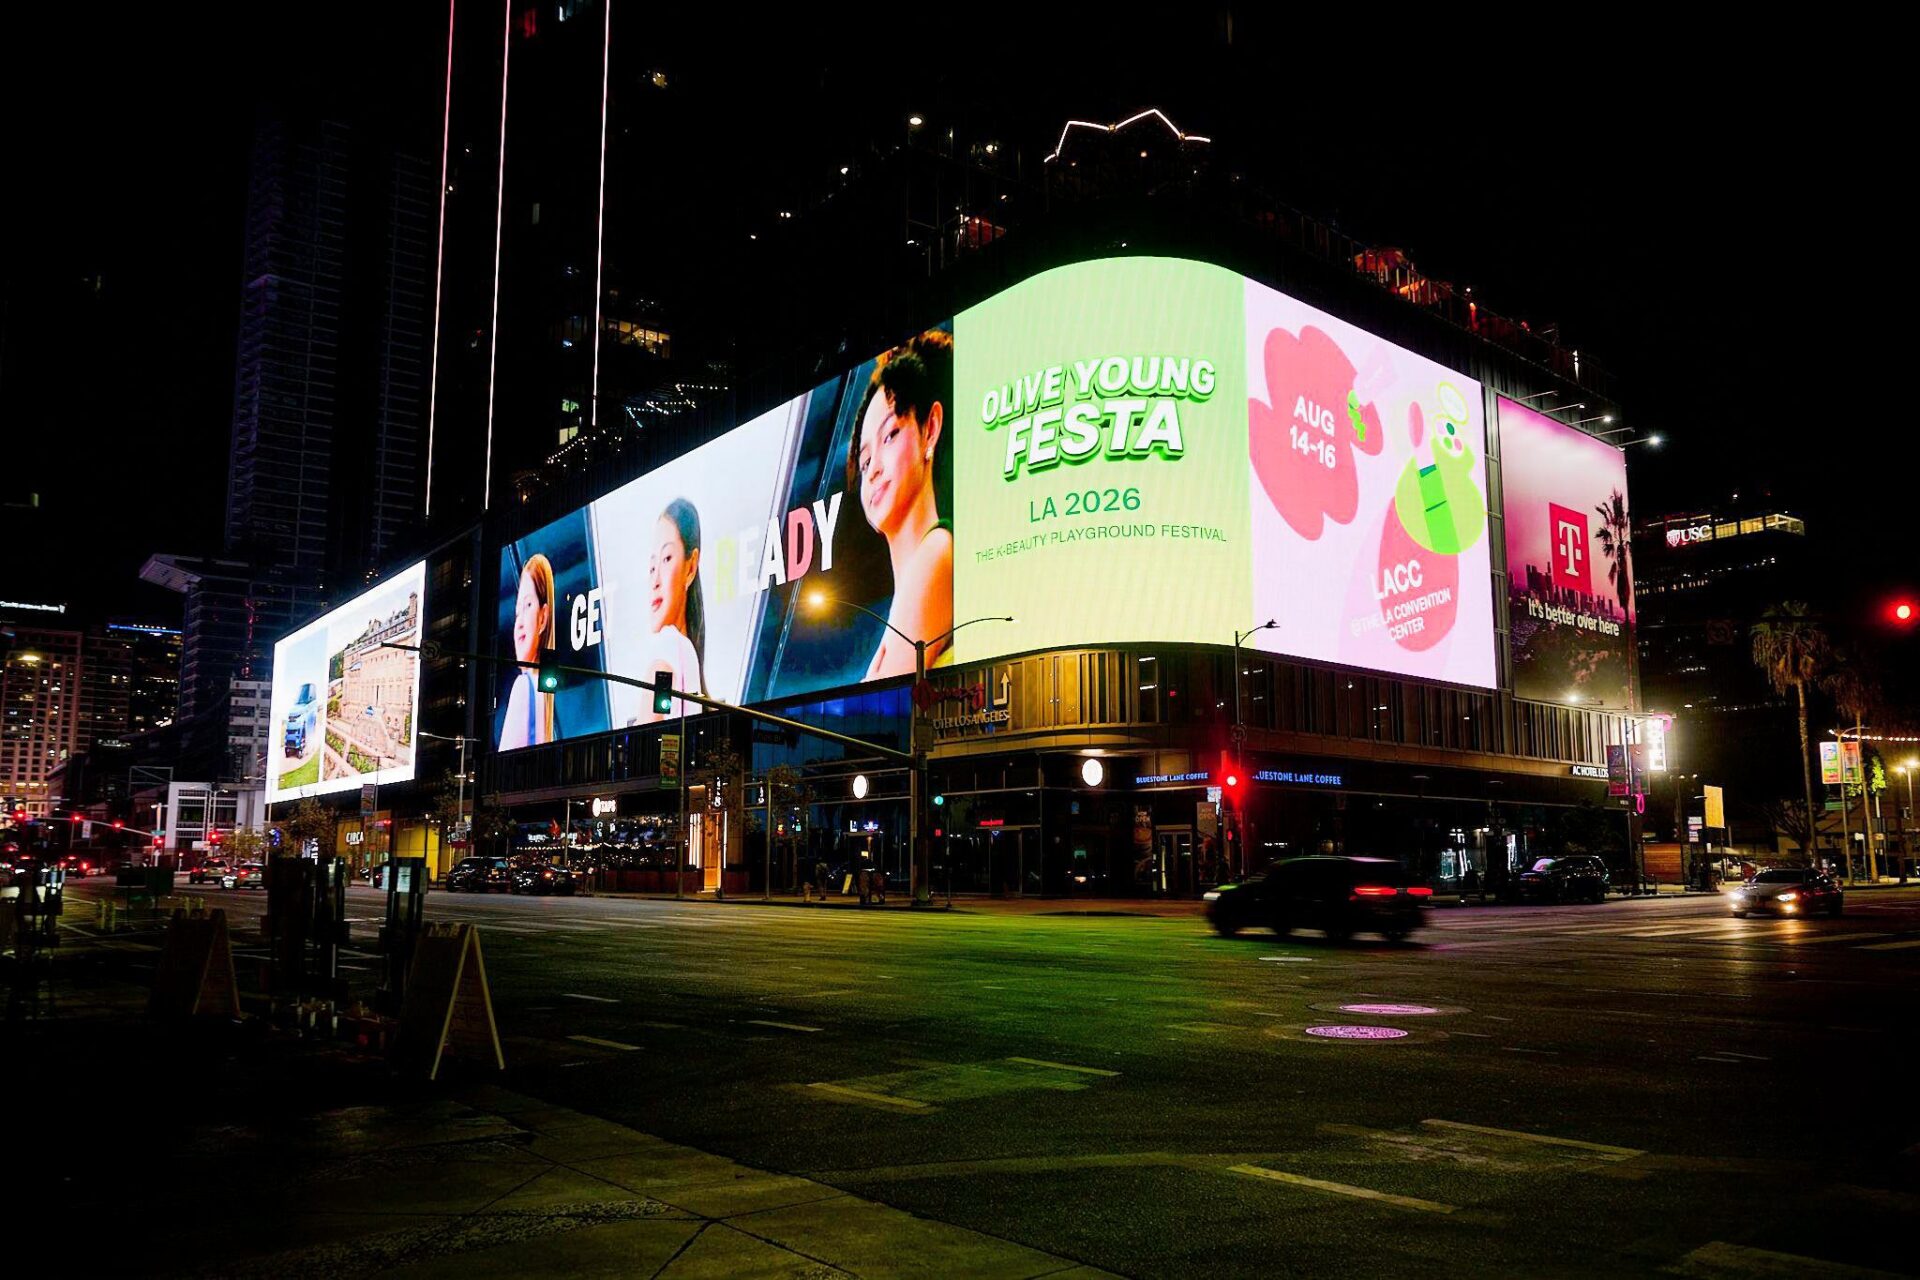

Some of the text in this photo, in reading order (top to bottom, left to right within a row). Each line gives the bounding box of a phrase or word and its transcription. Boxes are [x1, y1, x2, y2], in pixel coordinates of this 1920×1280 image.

[981, 356, 1216, 426] OLIVE YOUNG
[1293, 395, 1336, 438] AUG
[1003, 398, 1184, 478] FESTA
[1289, 425, 1337, 470] 14-16
[1030, 487, 1141, 524] LA 2026
[715, 490, 844, 606] READY
[975, 523, 1228, 564] THE K-BEAUTY PLAYGROUND FESTIVAL
[1558, 519, 1583, 577] T
[1680, 523, 1711, 543] USC
[1370, 559, 1424, 601] LACC
[1381, 608, 1394, 625] LA
[1393, 588, 1452, 620] CONVENTION
[1528, 597, 1620, 637] It's better over here
[1388, 616, 1425, 641] CENTER
[1136, 772, 1208, 784] BLUESTONE LANE COFFEE
[1294, 773, 1314, 783] LANE
[1315, 774, 1342, 785] COFFEE
[1572, 765, 1581, 776] AC
[1581, 766, 1599, 777] HOTEL
[345, 831, 364, 843] CIRCA
